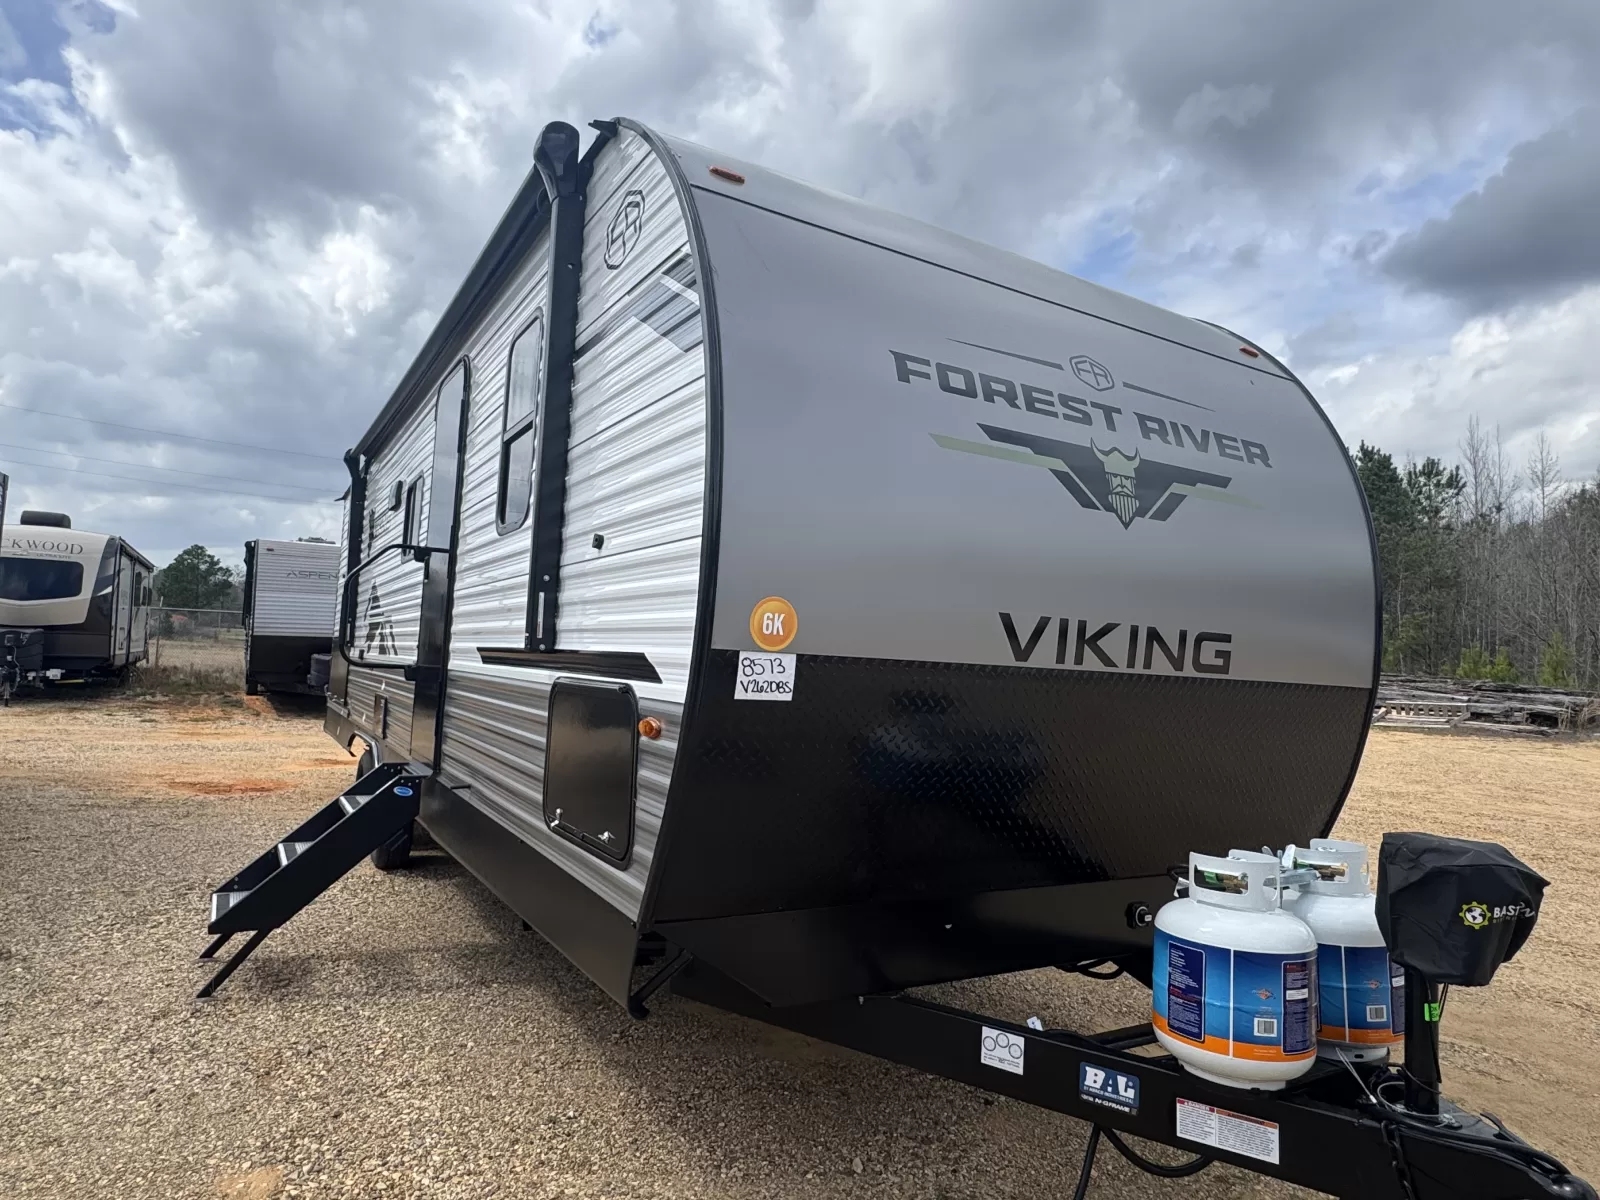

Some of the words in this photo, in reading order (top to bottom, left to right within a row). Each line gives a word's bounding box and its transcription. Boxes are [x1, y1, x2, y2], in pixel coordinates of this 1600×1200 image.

[888, 350, 1123, 432] FOREST
[1132, 411, 1273, 468] RIVER
[286, 570, 339, 580] ASPEN
[762, 612, 785, 636] 6K
[998, 611, 1232, 675] VIKING
[741, 657, 786, 677] 8573
